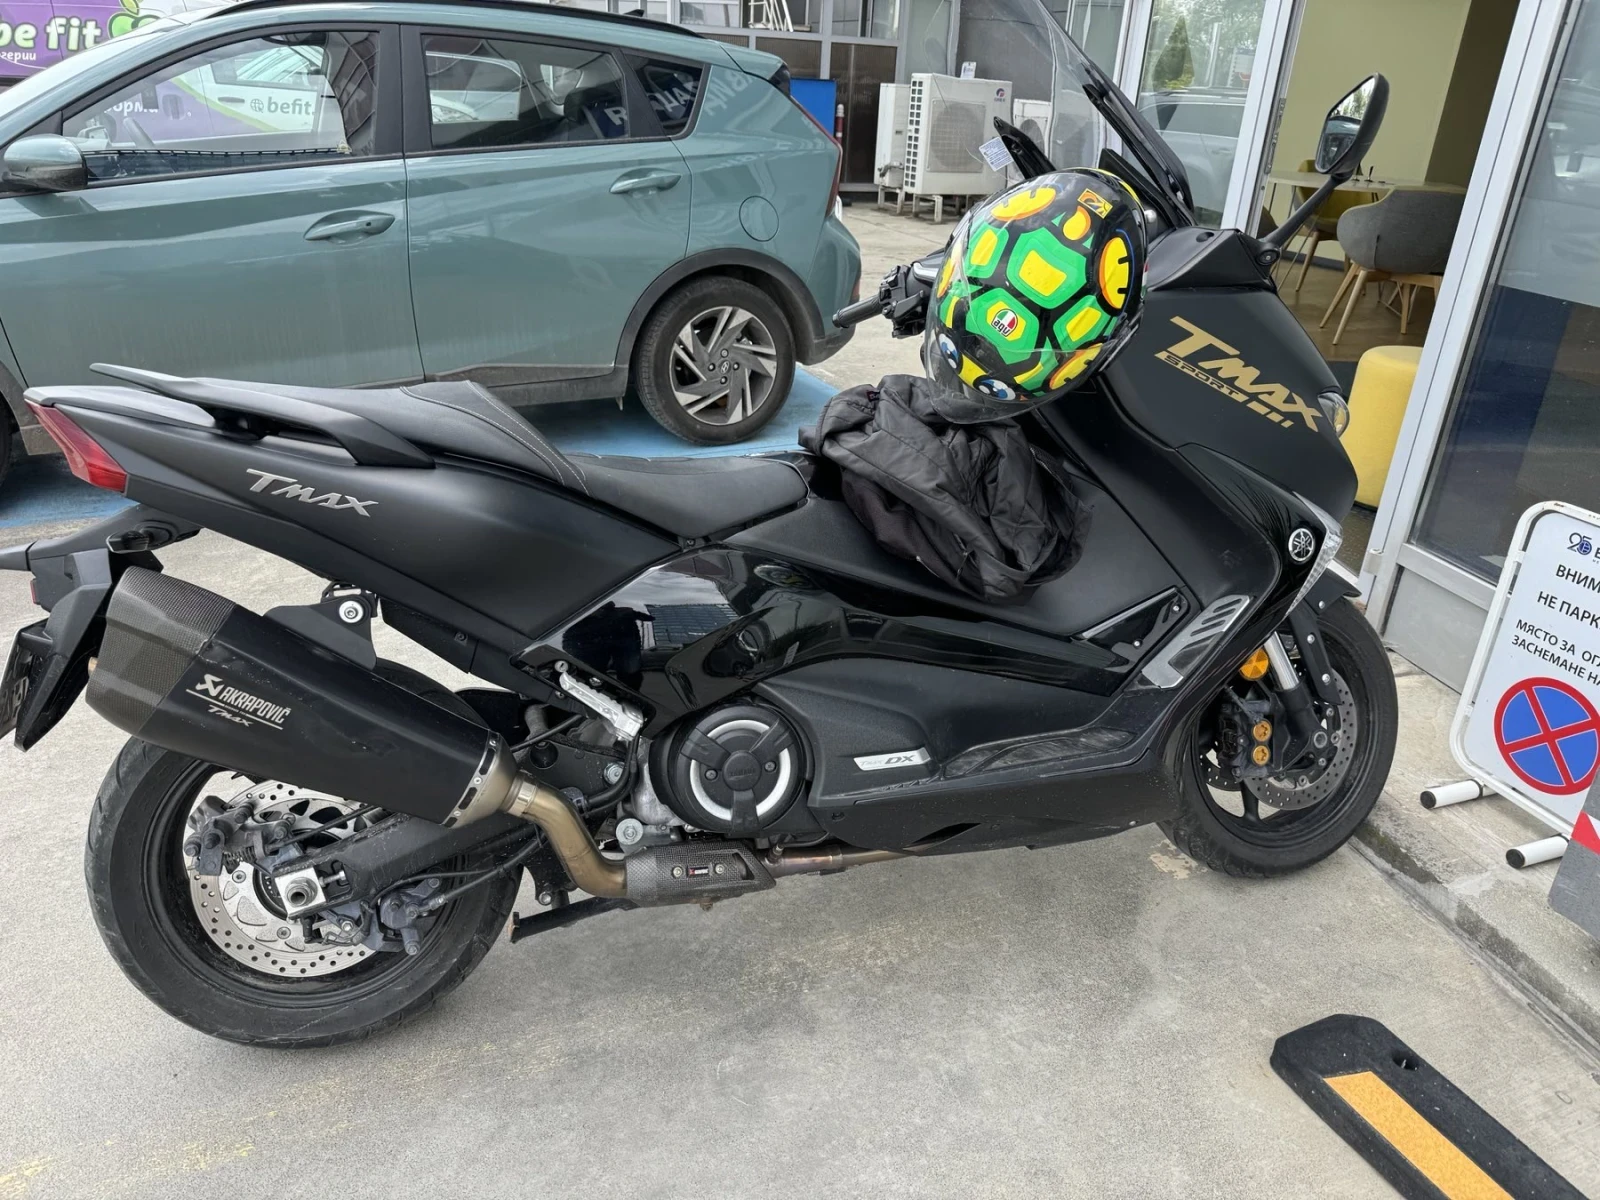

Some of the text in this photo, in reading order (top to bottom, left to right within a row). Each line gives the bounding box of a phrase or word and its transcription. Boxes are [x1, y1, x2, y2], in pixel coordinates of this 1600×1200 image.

[44, 15, 102, 51] fit
[0, 51, 37, 63] герии
[993, 319, 1010, 335] agv
[1163, 353, 1240, 397] SPORT
[1169, 315, 1323, 432] TMAX
[246, 468, 379, 517] TMAX
[1537, 591, 1600, 629] НЕ ПАРК
[1516, 619, 1558, 646] МЯСТО
[1559, 640, 1576, 656] ЗА
[1511, 634, 1586, 679] ЗАСНЕМАНЕ
[207, 704, 254, 727] TMAX
[885, 754, 916, 765] DX
